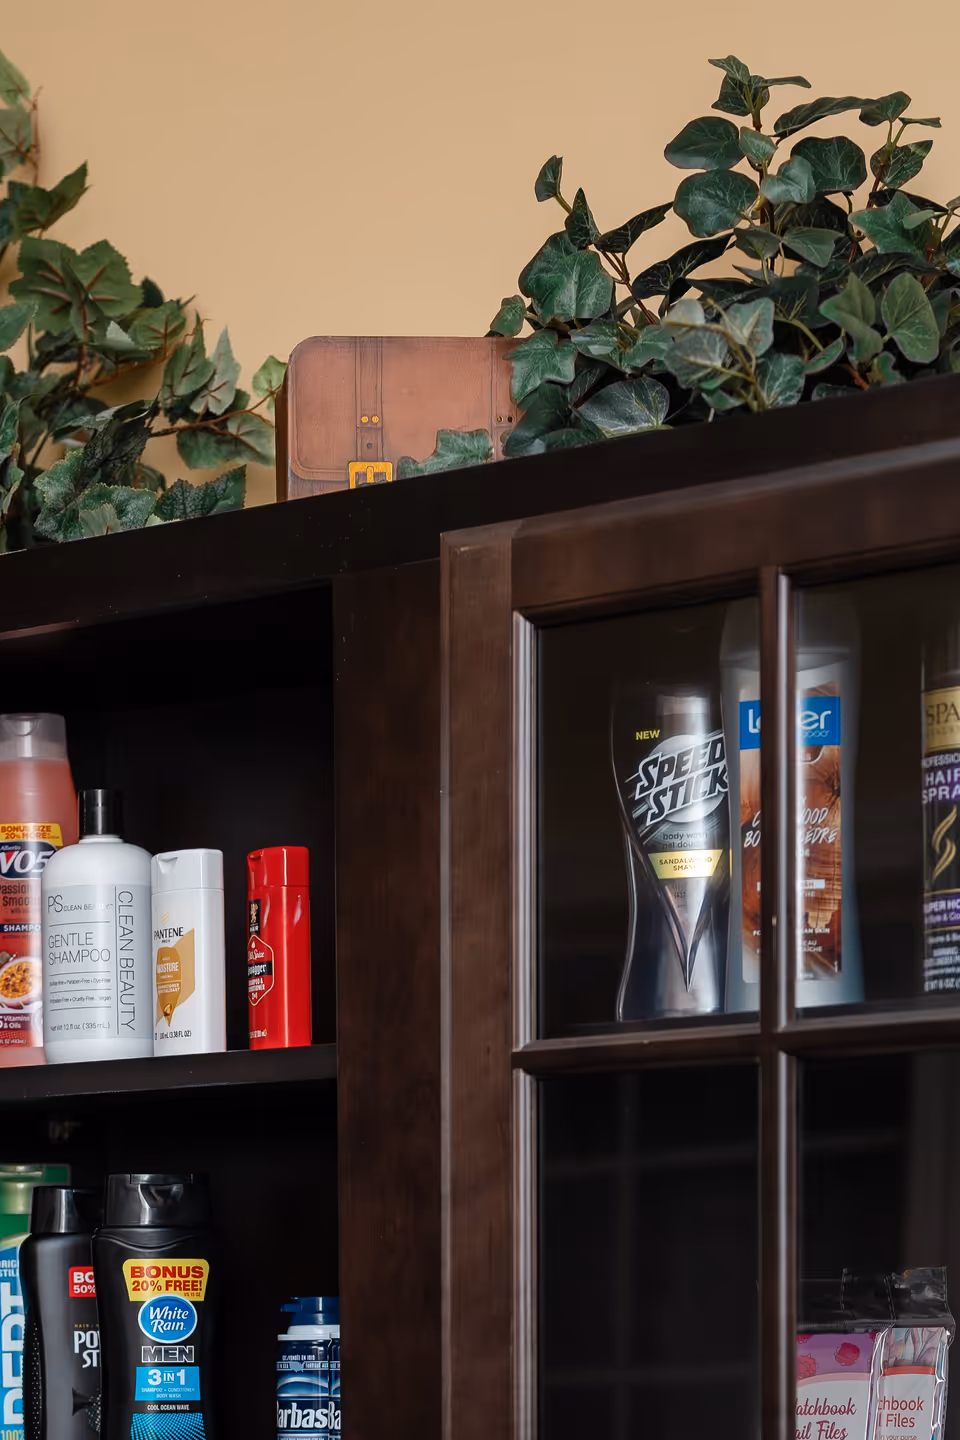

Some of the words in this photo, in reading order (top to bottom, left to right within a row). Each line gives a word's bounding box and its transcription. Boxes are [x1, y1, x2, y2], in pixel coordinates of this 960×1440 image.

[635, 729, 661, 741] NEW
[635, 735, 726, 800] SPEED
[646, 764, 728, 826] STICK
[662, 832, 684, 841] body
[48, 894, 63, 914] PS
[63, 904, 82, 912] CLEAN
[118, 890, 134, 952] CLEAN
[48, 932, 94, 949] GENTLE
[154, 926, 184, 940] PANTENE
[48, 949, 111, 966] SHAMPOO
[120, 958, 136, 1031] BEAUTY
[130, 1265, 204, 1279] BONUS
[73, 1284, 96, 1294] 50%
[132, 1280, 162, 1292] 20%
[165, 1279, 203, 1292] FREE!
[149, 1305, 189, 1320] White
[151, 1319, 184, 1334] Rain
[141, 1345, 195, 1363] MEN
[796, 1397, 857, 1416] atchbook
[886, 1413, 915, 1428] Files
[796, 1422, 812, 1440] ail
[816, 1420, 848, 1440] Files
